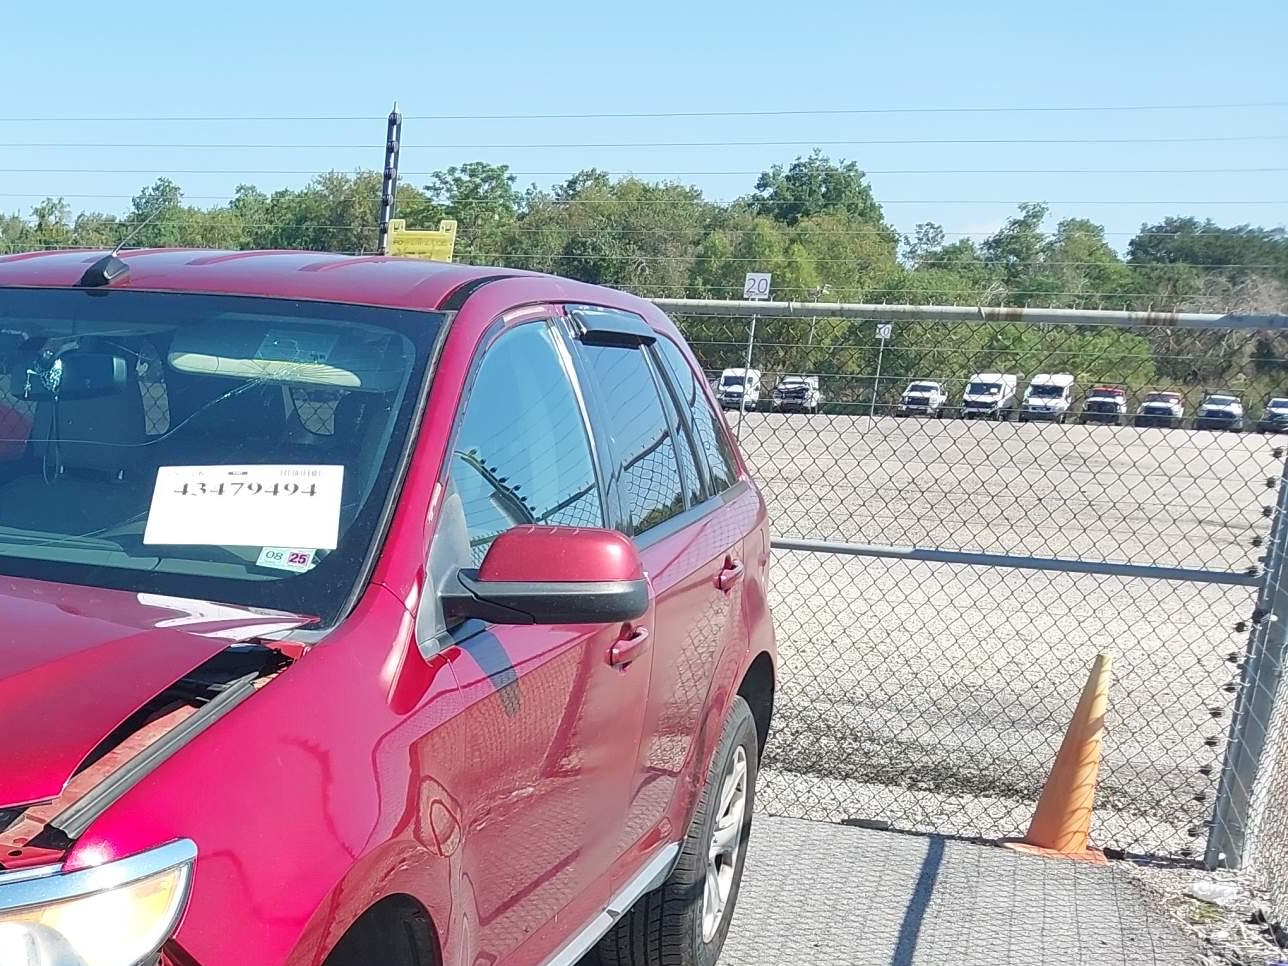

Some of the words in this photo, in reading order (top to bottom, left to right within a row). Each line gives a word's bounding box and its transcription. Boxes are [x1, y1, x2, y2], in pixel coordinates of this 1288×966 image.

[746, 278, 768, 294] 20
[173, 481, 317, 497] 43479494
[265, 550, 283, 561] 08
[288, 552, 308, 564] 25
